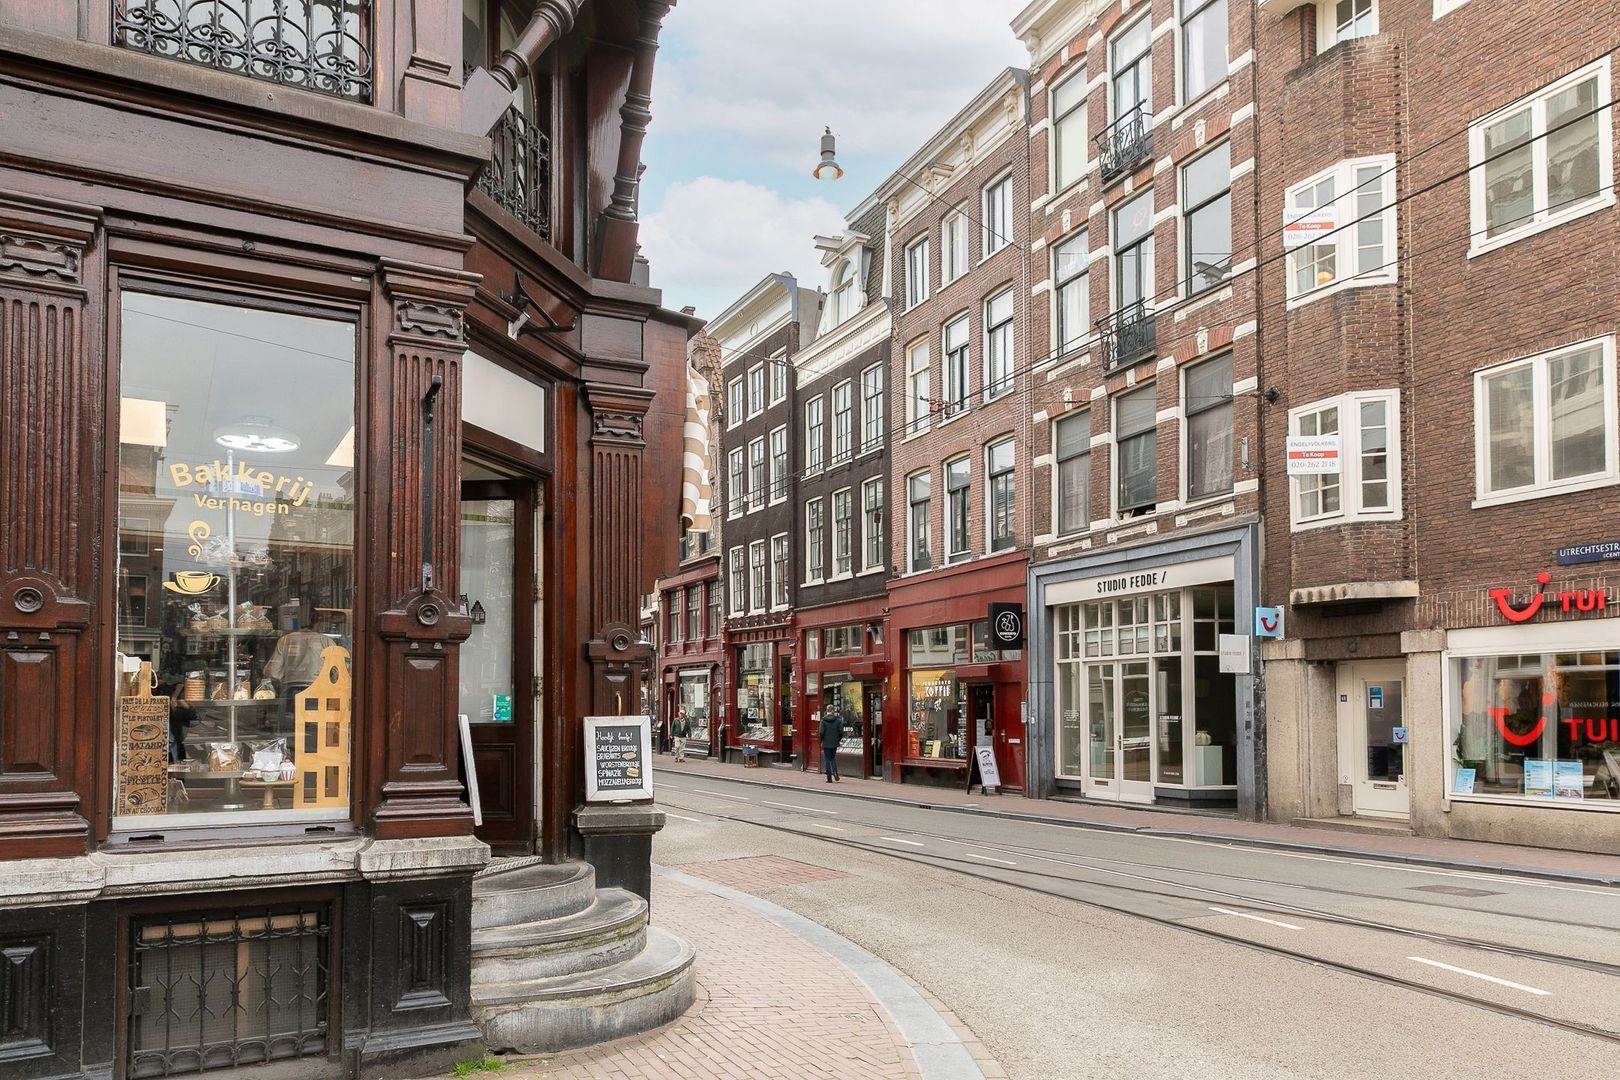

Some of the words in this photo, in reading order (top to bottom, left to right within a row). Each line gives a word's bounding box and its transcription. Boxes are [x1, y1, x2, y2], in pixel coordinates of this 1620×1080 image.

[170, 460, 313, 506] Bakkerij
[193, 494, 289, 516] Verhagen
[1560, 542, 1620, 557] UTRECHTSESTR
[1097, 578, 1127, 593] STUDIO
[1130, 572, 1157, 588] FEDDE
[1556, 588, 1606, 612] TUI
[1564, 718, 1618, 742] TUI
[140, 806, 166, 814] CHOCOLAT
